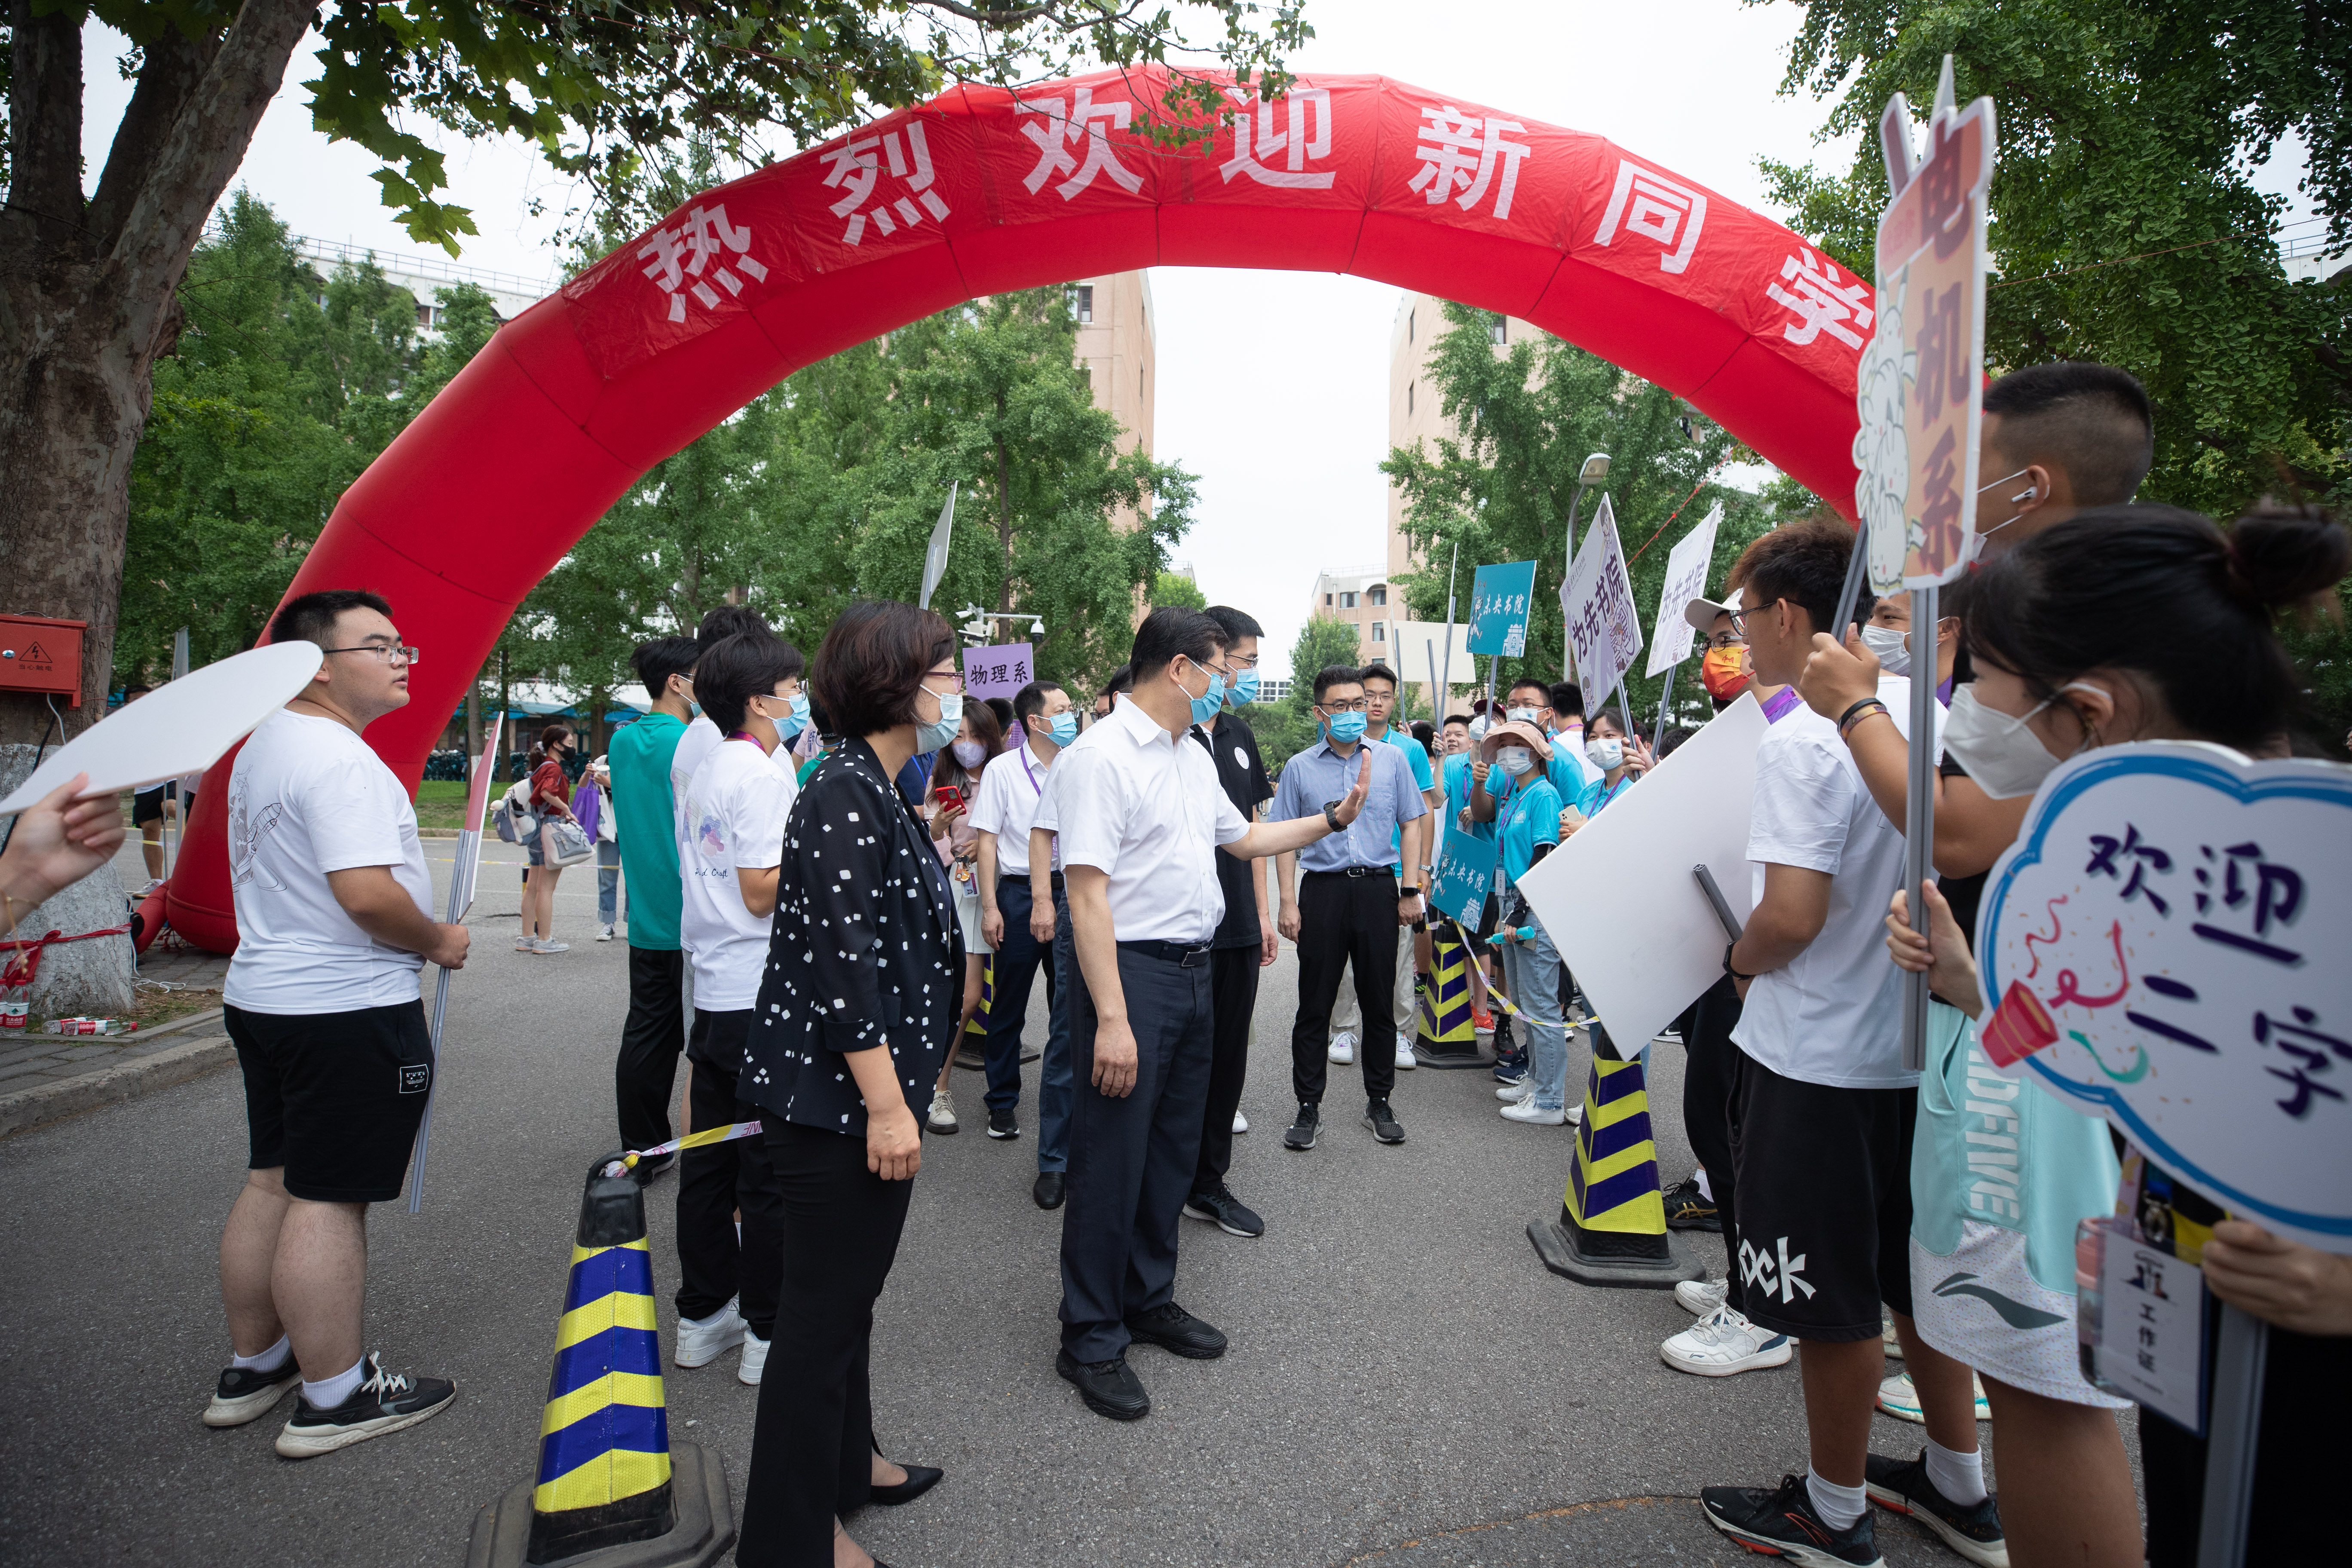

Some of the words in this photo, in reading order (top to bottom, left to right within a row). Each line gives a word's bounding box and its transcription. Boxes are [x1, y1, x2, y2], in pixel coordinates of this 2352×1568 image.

[637, 86, 1874, 350] 热烈欢迎新同学
[1913, 119, 1972, 577] 电机系
[1483, 593, 1524, 616] 未央书院
[1572, 553, 1624, 664] 为先书院
[1659, 558, 1706, 625] 为先书院
[970, 661, 1028, 686] 物理系
[711, 868, 729, 879] Craft
[1448, 858, 1485, 893] 未央书院
[2085, 821, 2305, 964] 欢迎
[2125, 975, 2352, 1118] 二字
[1736, 1223, 1817, 1304] ock
